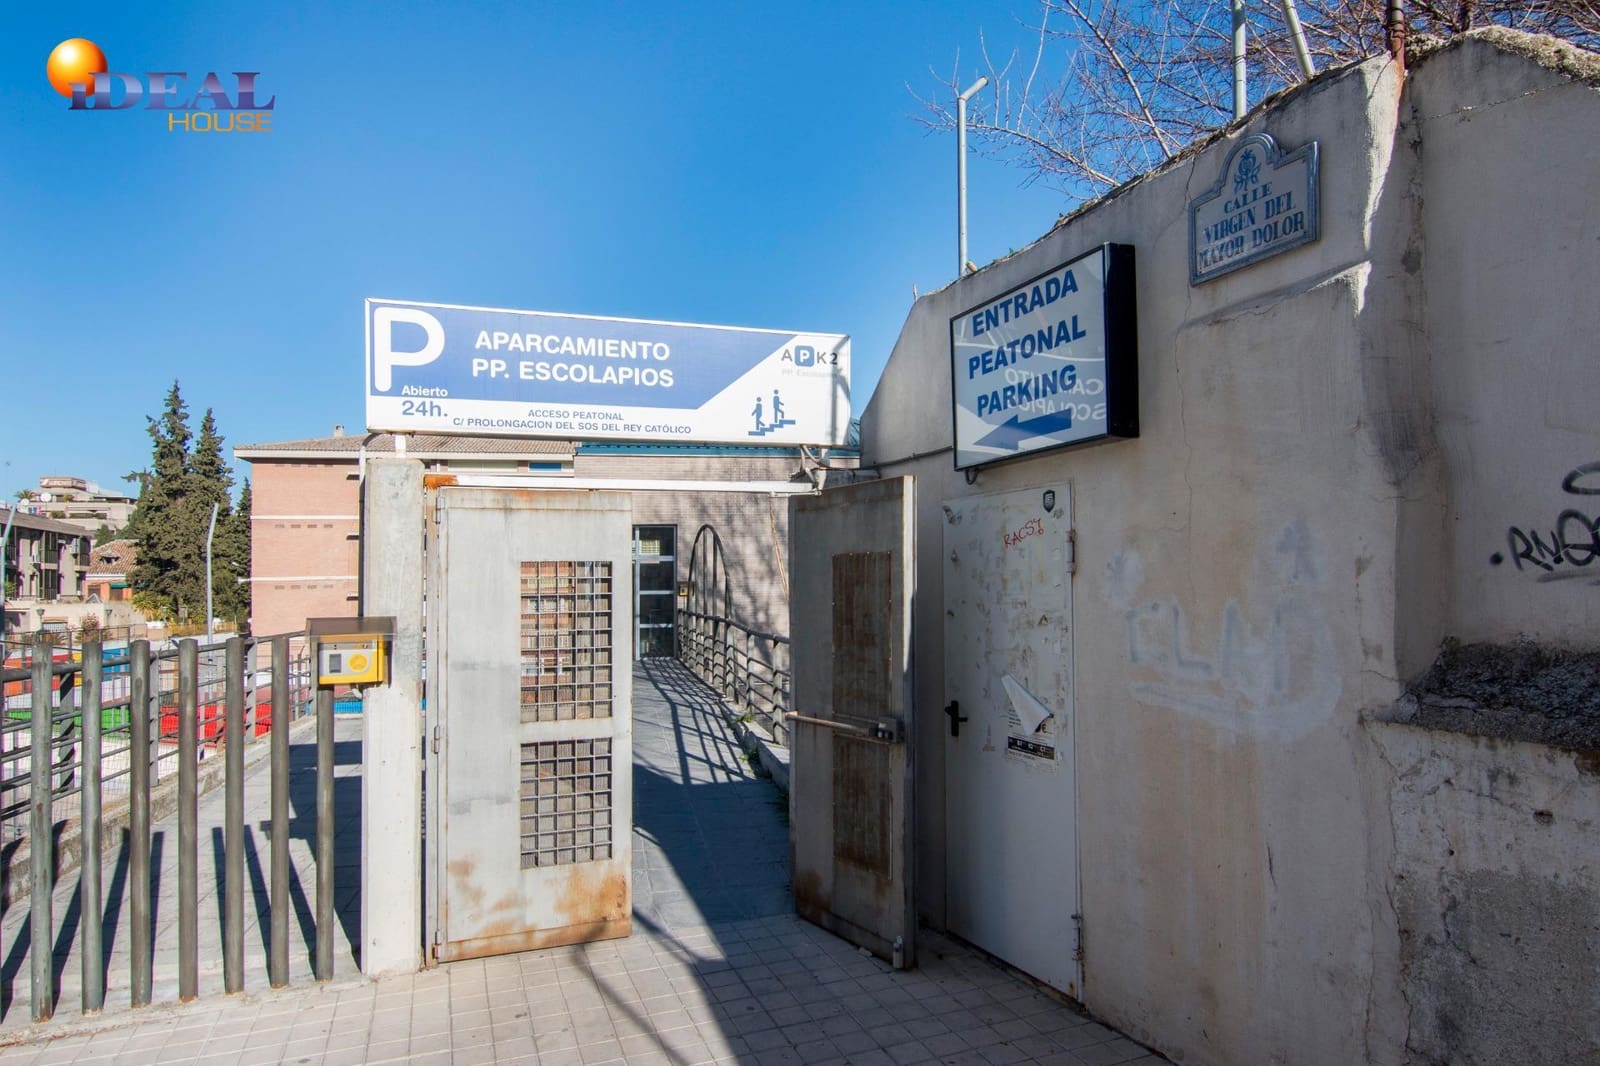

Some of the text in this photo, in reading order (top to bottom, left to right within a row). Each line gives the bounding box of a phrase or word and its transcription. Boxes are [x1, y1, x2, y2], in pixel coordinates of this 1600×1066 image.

[1223, 182, 1273, 214] CALLE
[1203, 191, 1297, 243] VIRGEN DEL
[1252, 211, 1306, 250] DOLOR
[972, 269, 1079, 337] ENTRADA
[374, 306, 446, 393] P
[475, 330, 671, 361] APARCAMIENTO
[968, 314, 1087, 380] PEATONAL
[472, 358, 674, 388] PP. ESCOLAPIOS
[401, 385, 448, 397] Abierto
[976, 364, 1077, 418] PARKING
[401, 400, 448, 417] 24h.
[528, 409, 624, 421] ACCESO PEATONAL
[453, 417, 692, 434] C/ PROLONGACION DEL SOS DEL REY CATÓLICO
